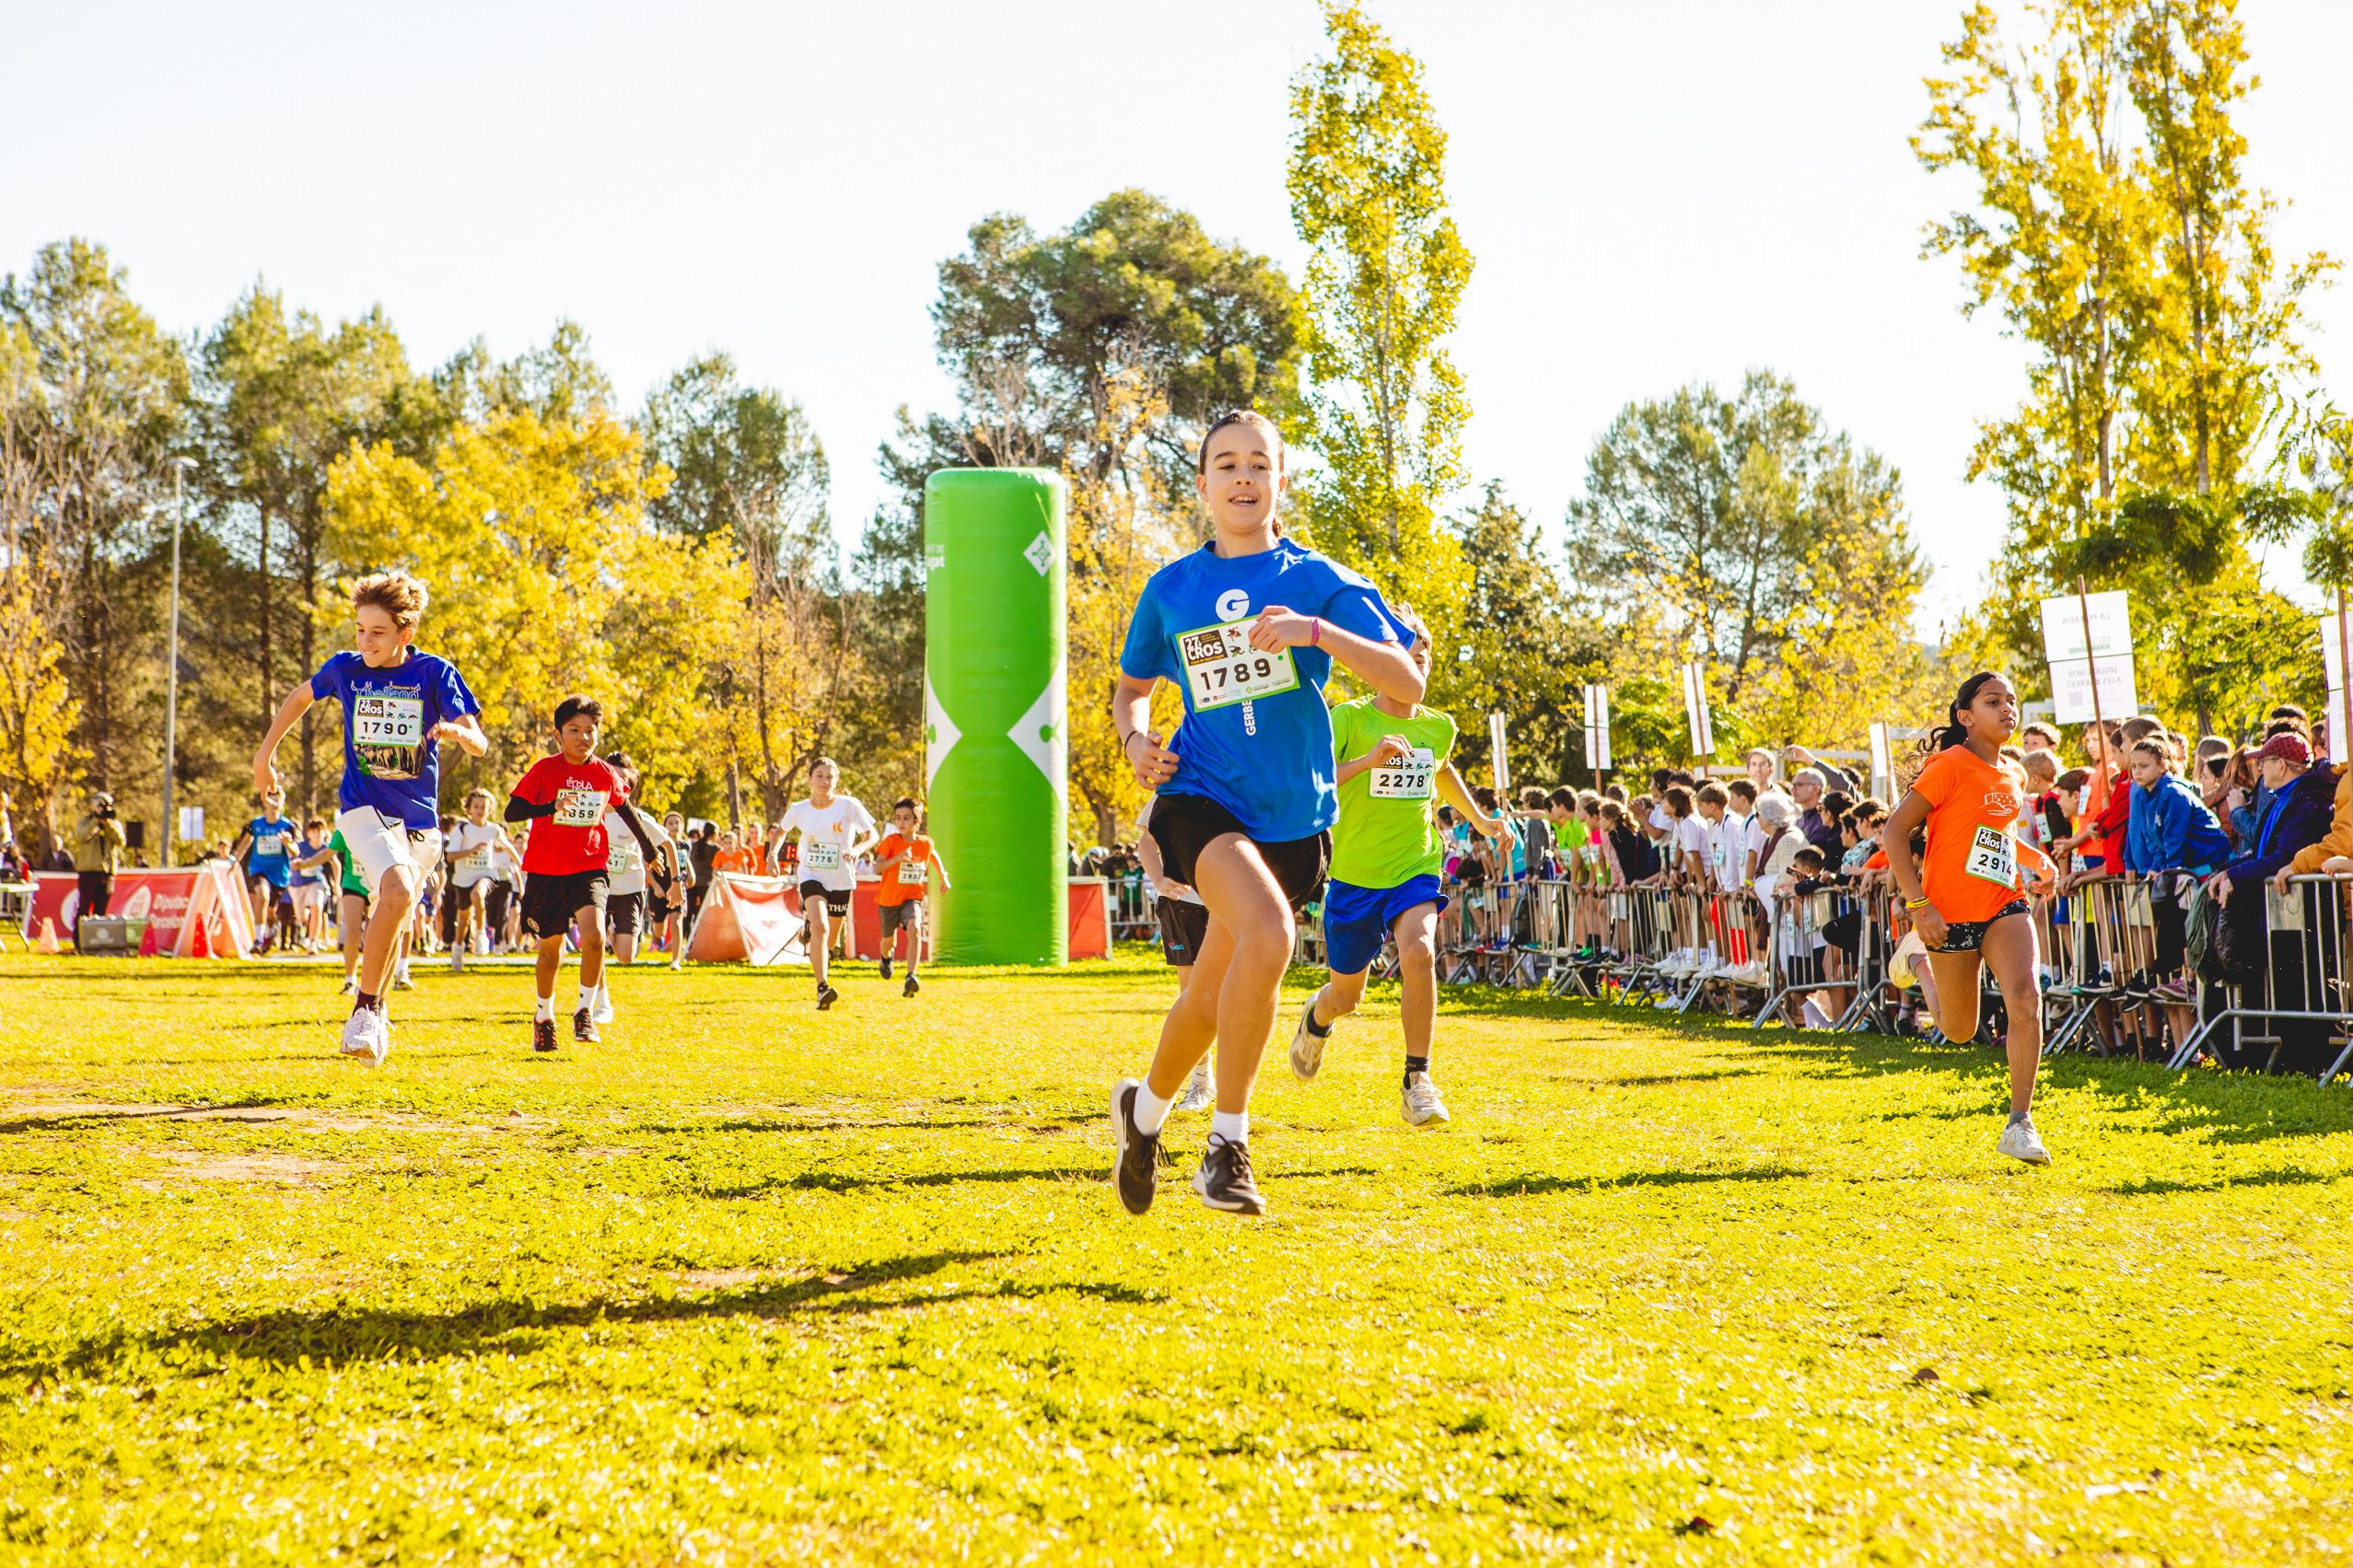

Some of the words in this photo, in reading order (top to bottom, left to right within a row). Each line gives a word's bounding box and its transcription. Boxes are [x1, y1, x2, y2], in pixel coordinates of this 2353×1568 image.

[1187, 642, 1223, 660] CROS
[1200, 658, 1271, 691] 1789
[359, 706, 382, 714] CROS
[363, 722, 408, 735] 1790
[1379, 773, 1425, 787] 2278
[563, 809, 594, 818] 859
[1979, 836, 2000, 850] CROS
[810, 855, 832, 864] 2775
[1978, 854, 2011, 876] 2914
